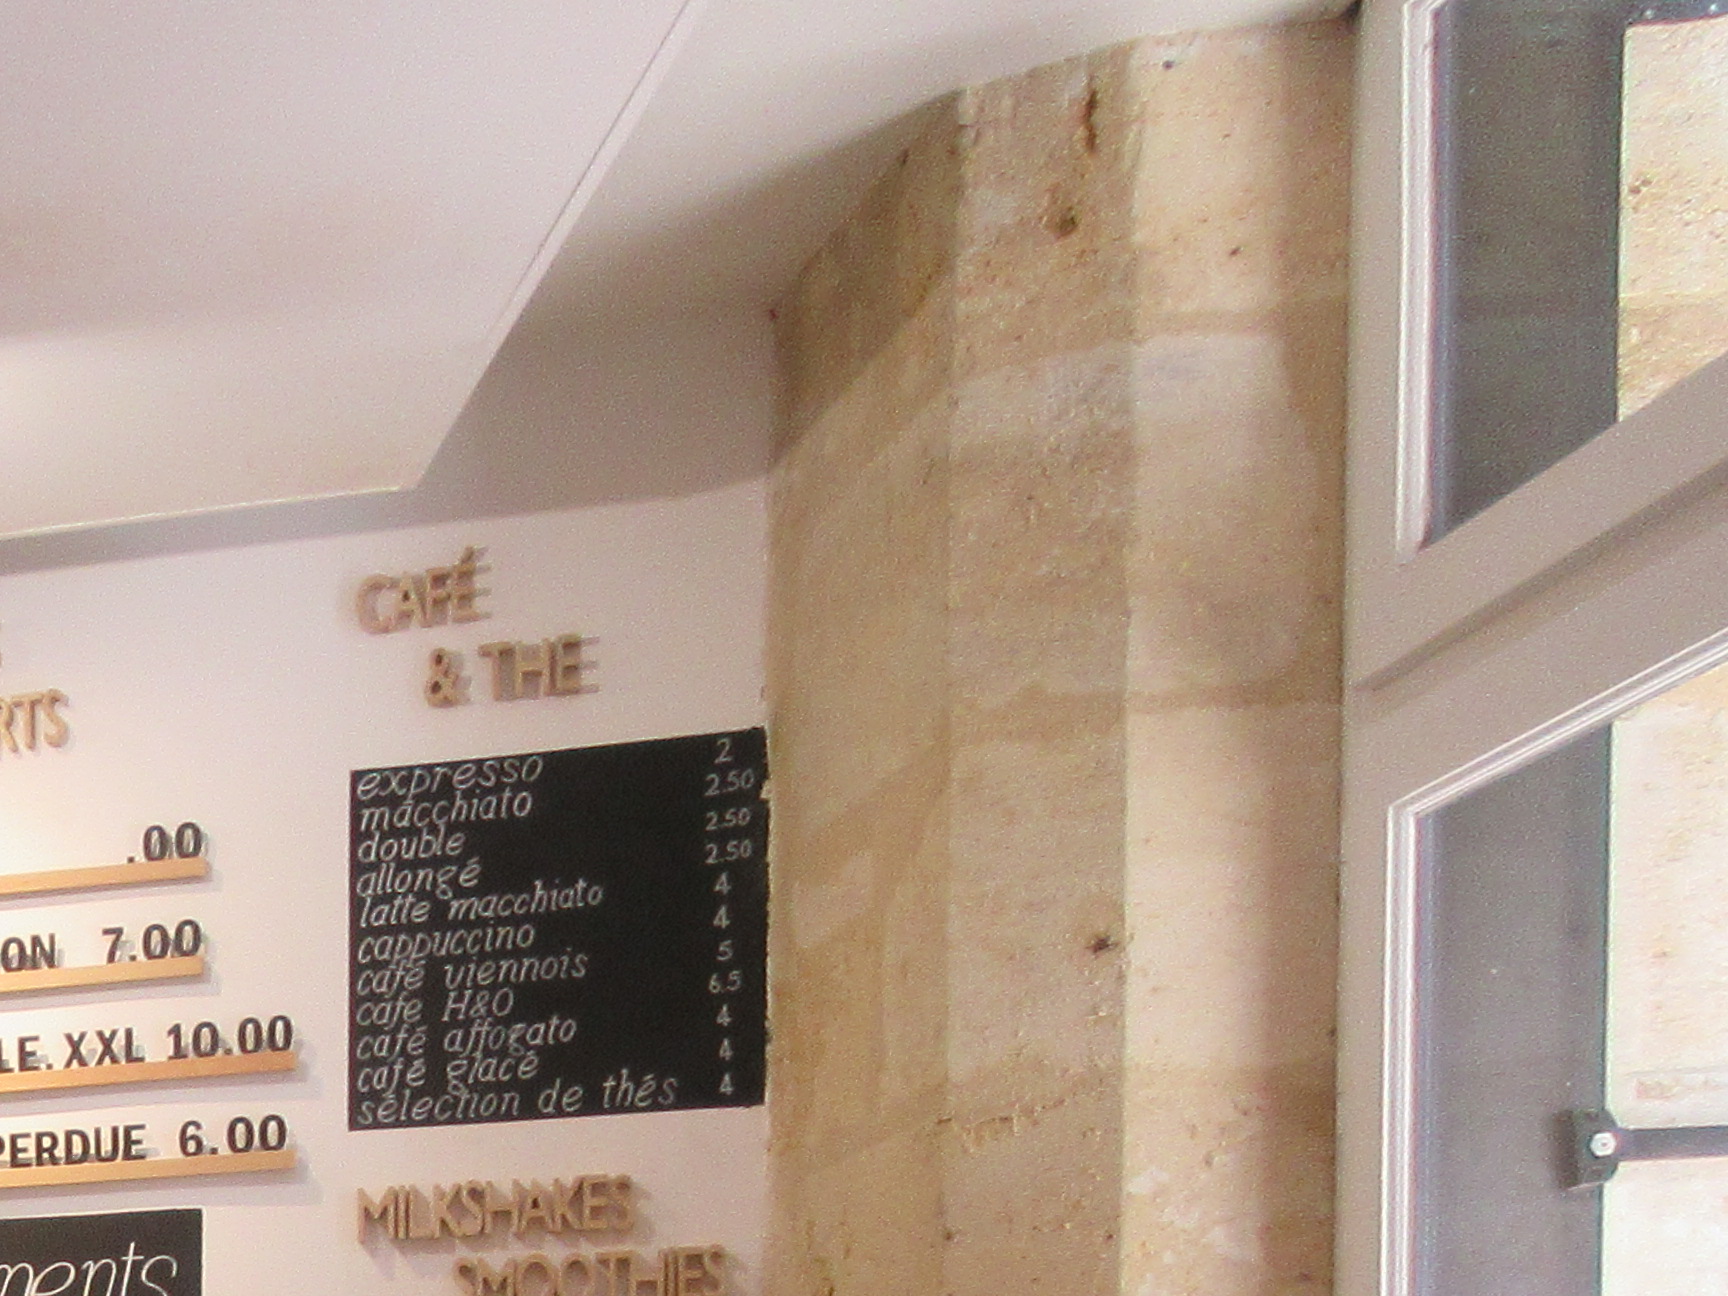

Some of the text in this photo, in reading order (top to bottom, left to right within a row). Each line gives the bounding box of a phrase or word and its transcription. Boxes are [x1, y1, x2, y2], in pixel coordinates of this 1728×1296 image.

[353, 545, 487, 634] CAFÉ
[424, 633, 592, 707] & THE
[357, 738, 733, 801] expresso 2
[360, 768, 755, 831] macchiato 2.50
[358, 807, 751, 863] double 2.50
[357, 839, 752, 899] allongé 2.50
[360, 872, 732, 927] latte macchiato 4
[101, 919, 203, 966] 7.00
[357, 905, 731, 967] cappuccino 4
[357, 940, 734, 998] café viennois 5
[442, 988, 514, 1022] H&O
[444, 1015, 578, 1057] affogato
[716, 1004, 732, 1027] 4
[166, 1014, 293, 1062] 10.00
[357, 1037, 734, 1097] café glacé 4
[357, 1067, 734, 1126] sélection de thés 4
[178, 1114, 288, 1158] 6.00
[357, 1174, 638, 1244] MILKSHAKES
